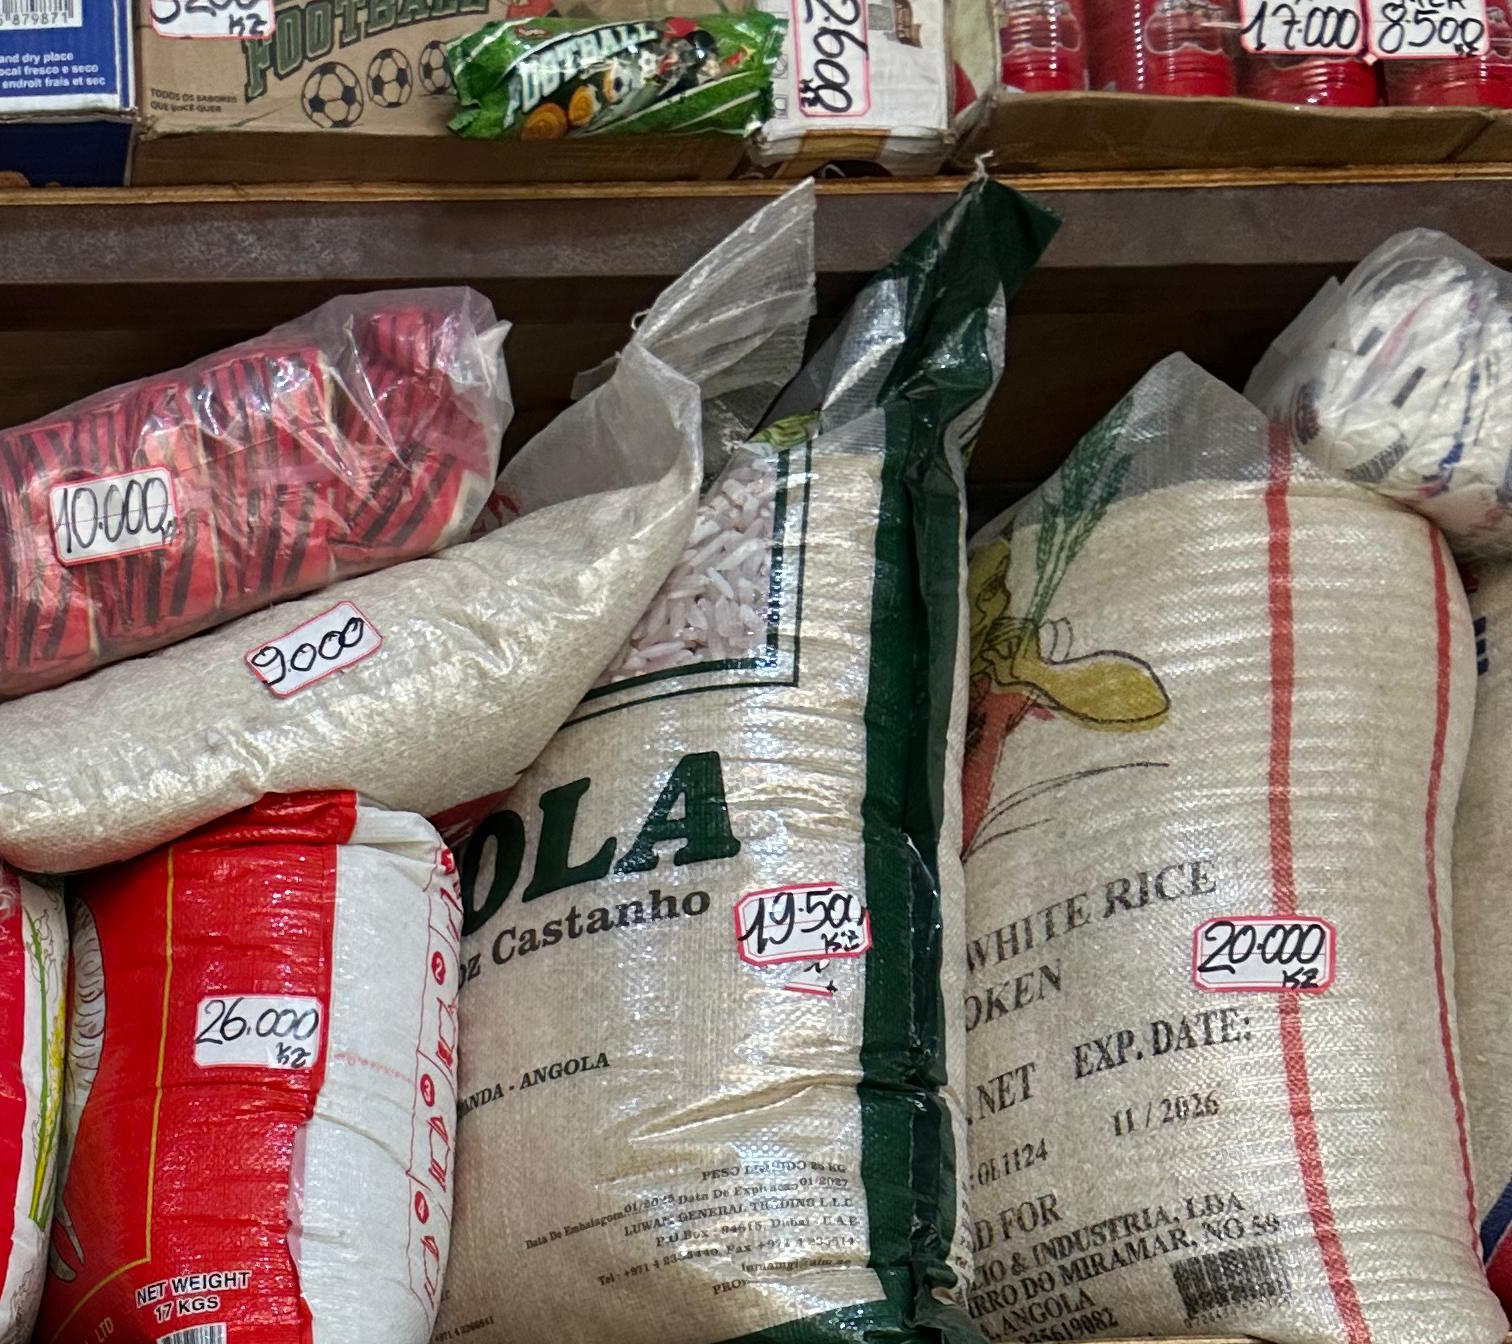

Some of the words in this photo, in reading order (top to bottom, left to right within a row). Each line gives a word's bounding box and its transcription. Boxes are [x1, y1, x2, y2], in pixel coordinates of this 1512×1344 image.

[1377, 4, 1485, 54] 8.500
[22, 52, 41, 65] dry
[43, 51, 74, 64] place
[53, 474, 172, 556] 10.000
[248, 616, 366, 687] 9.000
[491, 890, 711, 967] Castanho
[965, 892, 1090, 975] WHITE
[1100, 859, 1219, 920] RICE
[1198, 921, 1327, 974] 20.000
[194, 999, 320, 1045] 26.000
[1072, 1028, 1144, 1080] EXP.
[1150, 1007, 1252, 1056] DATE:
[518, 1051, 611, 1093] ANGOLA
[135, 1281, 167, 1307] NET
[169, 1269, 252, 1301] WEIGHT
[173, 1295, 221, 1319] KGS
